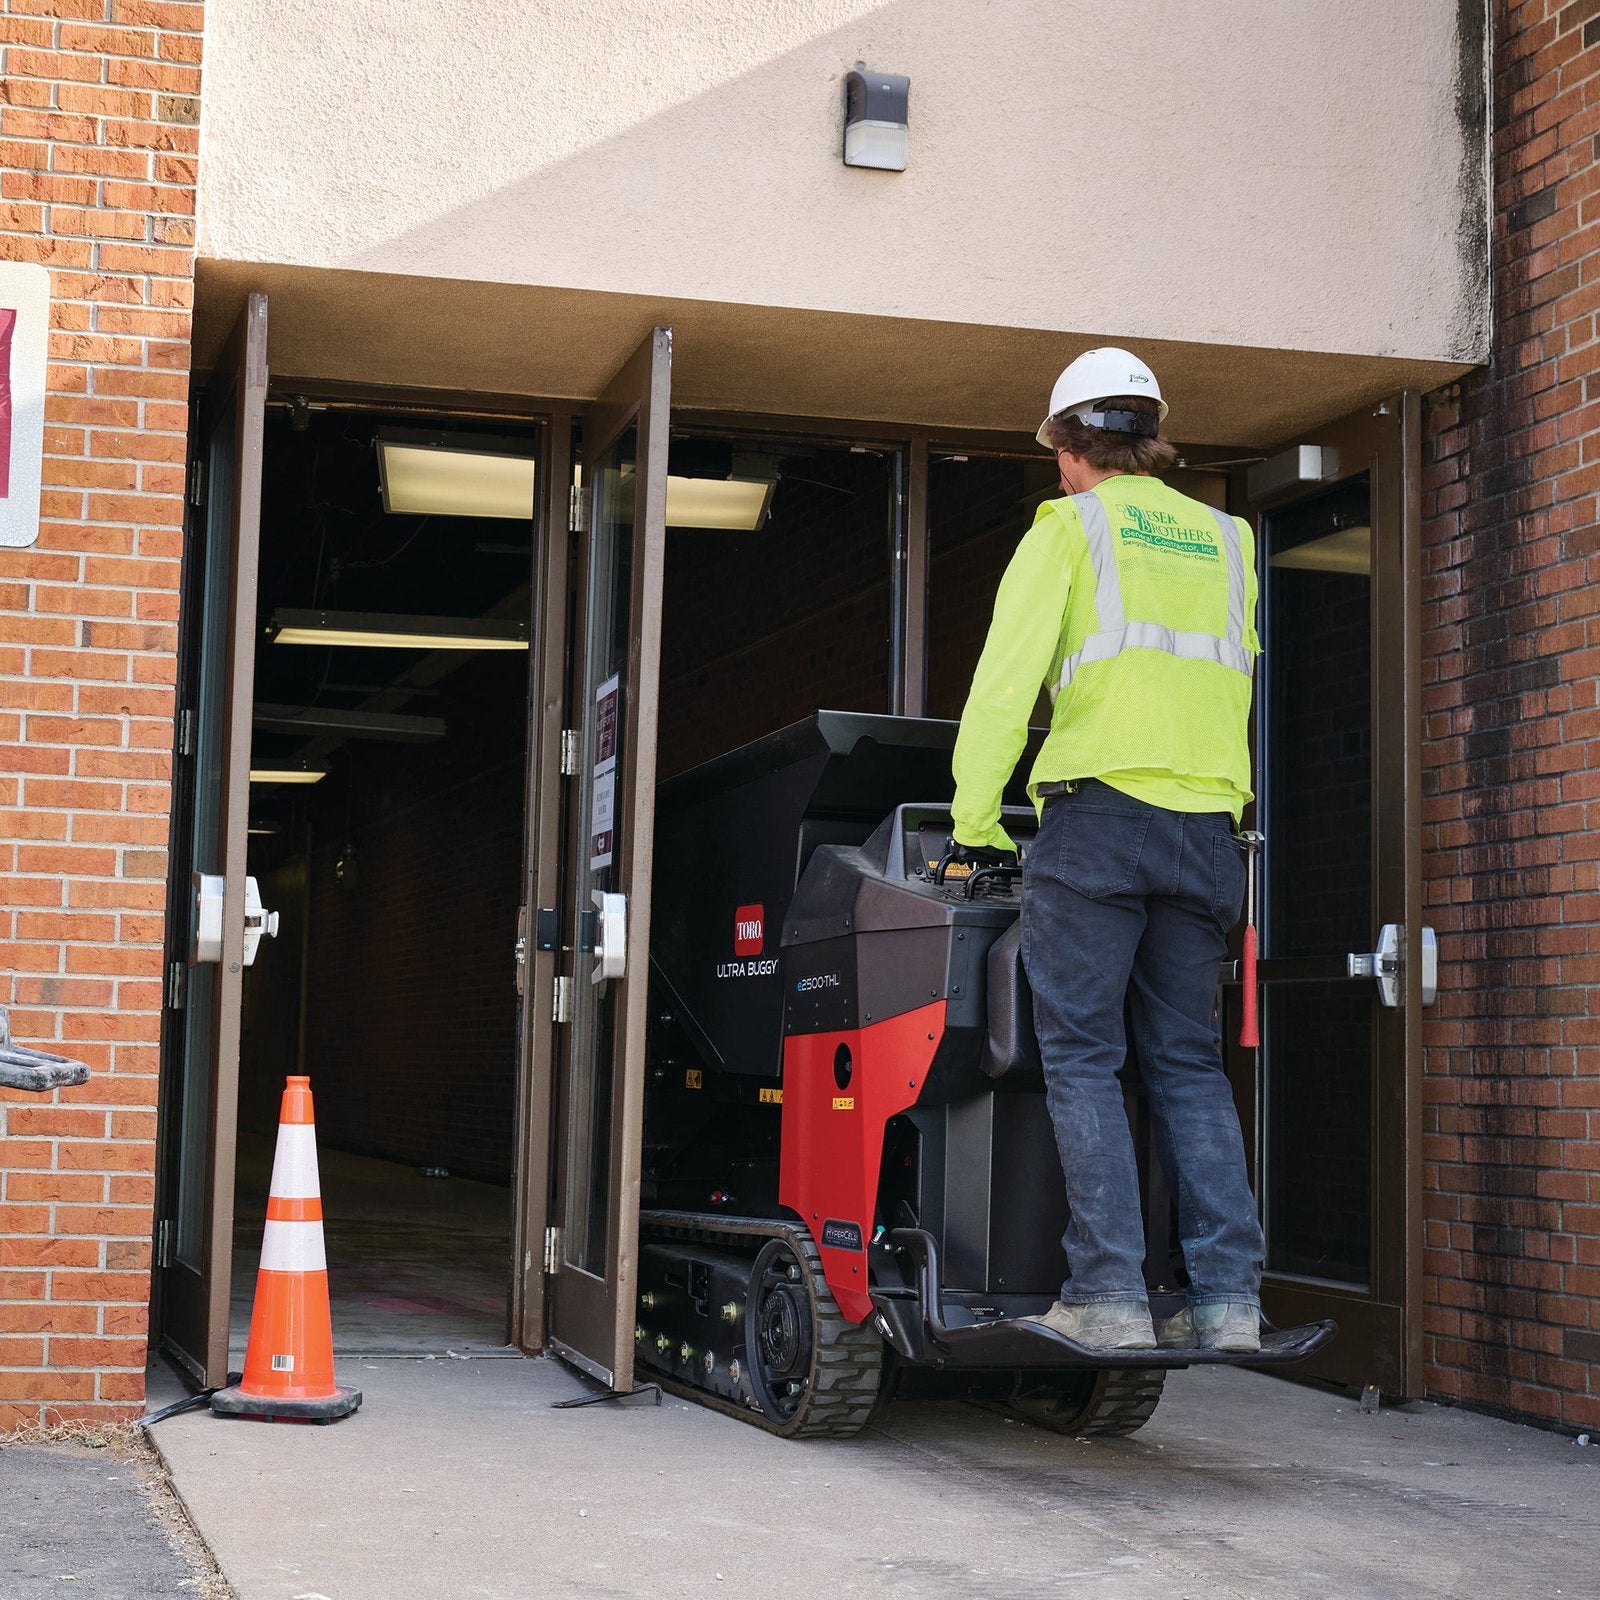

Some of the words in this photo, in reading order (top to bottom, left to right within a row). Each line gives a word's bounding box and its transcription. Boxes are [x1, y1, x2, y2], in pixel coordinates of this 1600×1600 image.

[1123, 528, 1153, 543] General
[1155, 536, 1199, 552] Contractor,
[1201, 545, 1217, 555] Inc.
[1142, 518, 1214, 543] BROTHERS
[737, 920, 762, 940] TORO
[717, 962, 746, 978] ULTRA
[747, 959, 778, 976] BUGGY
